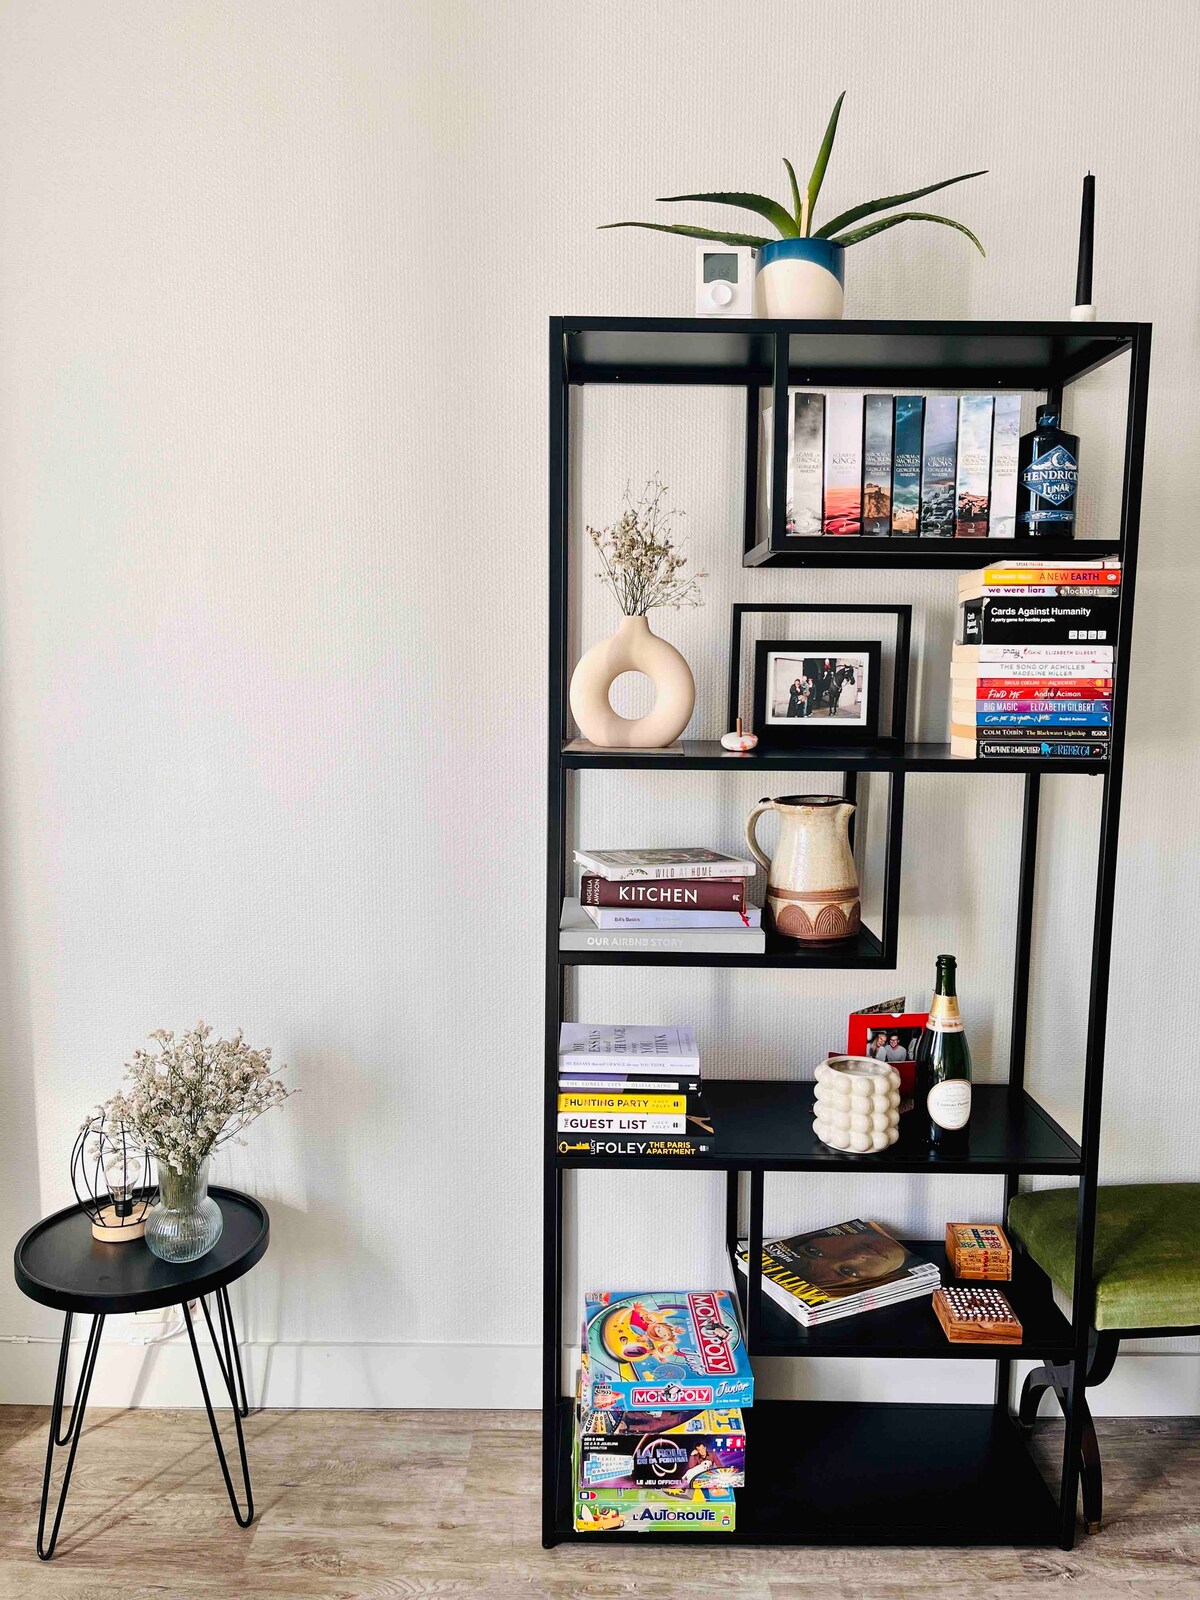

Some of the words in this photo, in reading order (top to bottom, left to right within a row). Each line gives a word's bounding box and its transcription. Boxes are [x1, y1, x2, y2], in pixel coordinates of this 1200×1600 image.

[832, 457, 857, 465] KINGS
[1043, 482, 1070, 497] LUNAR
[1047, 573, 1069, 581] NEW
[1071, 573, 1100, 581] EARTH
[1028, 586, 1046, 594] liars
[991, 607, 1016, 616] Cards
[1018, 607, 1050, 617] Against
[1051, 607, 1091, 617] Humanity
[1009, 690, 1024, 699] ME
[983, 702, 996, 711] BIG
[996, 702, 1018, 711] MAGIC
[1030, 702, 1065, 711] ELIZABETH
[1067, 702, 1095, 712] GILBERT
[655, 868, 674, 878] WILD
[691, 866, 712, 877] HOME
[619, 886, 698, 903] KITCHEN
[587, 937, 609, 946] OUR
[611, 937, 649, 946] AIRBNB
[650, 938, 684, 947] STORY
[654, 1034, 669, 1054] THINK
[570, 1099, 614, 1107] HUNTING
[570, 1119, 613, 1129] GUEST
[619, 1120, 647, 1129] LIST
[596, 1142, 647, 1154] FOLEY
[692, 1295, 730, 1371] MONOPOLY
[716, 1381, 750, 1398] Junior
[635, 1389, 709, 1403] MONOPOLY
